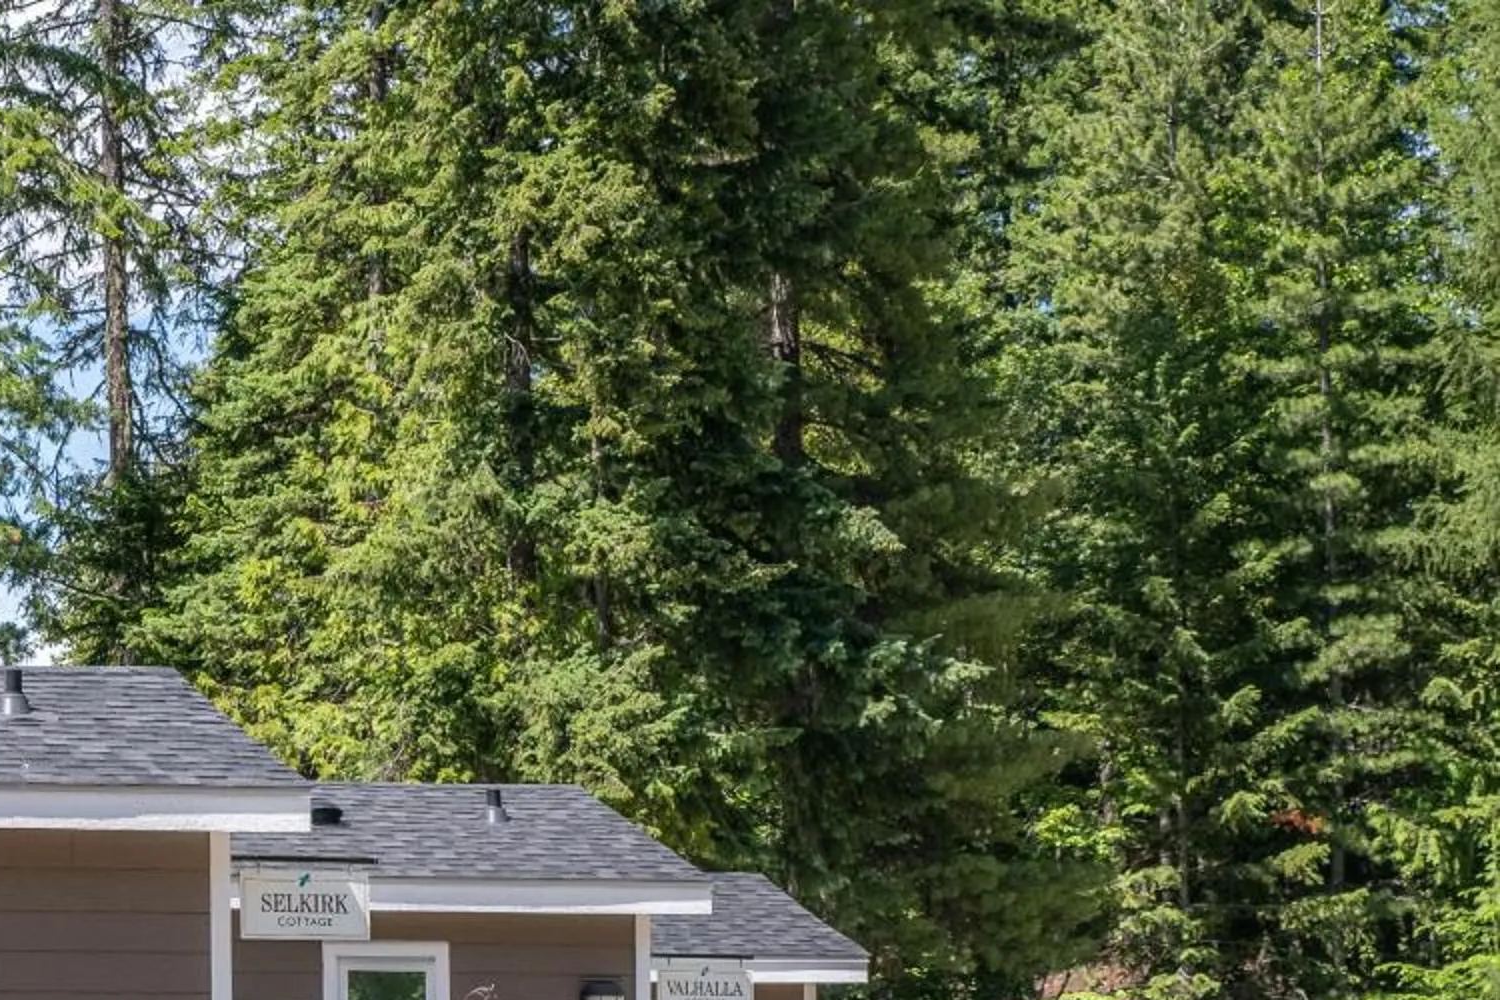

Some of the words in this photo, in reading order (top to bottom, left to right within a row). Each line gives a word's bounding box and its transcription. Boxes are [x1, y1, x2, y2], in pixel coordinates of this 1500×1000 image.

[261, 893, 348, 914] SELKIRK
[277, 915, 333, 927] COTTAGE
[667, 980, 743, 996] VALHALLA
